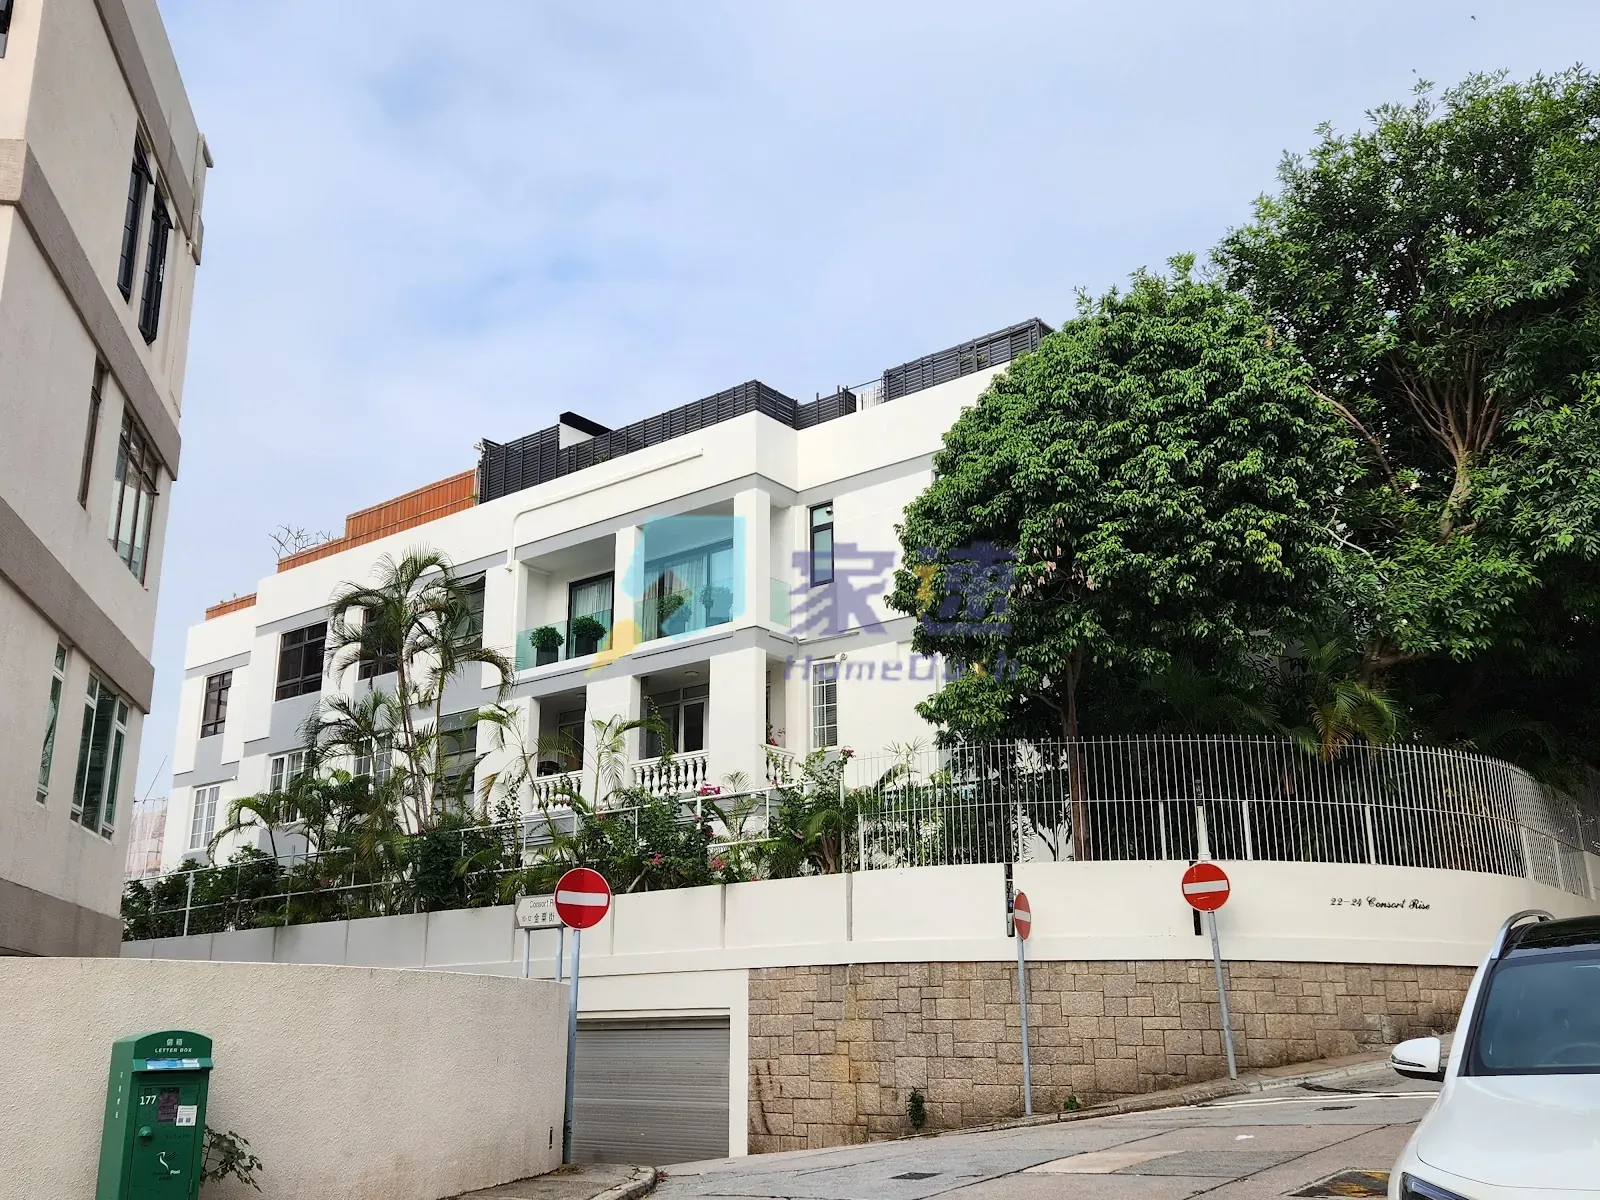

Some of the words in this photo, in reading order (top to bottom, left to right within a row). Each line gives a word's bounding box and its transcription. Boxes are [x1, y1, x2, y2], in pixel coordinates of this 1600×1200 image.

[530, 900, 549, 908] Consort
[1330, 897, 1362, 907] 22-24
[1366, 896, 1406, 908] Consort
[1408, 899, 1430, 910] Rise
[139, 1095, 156, 1105] 177
